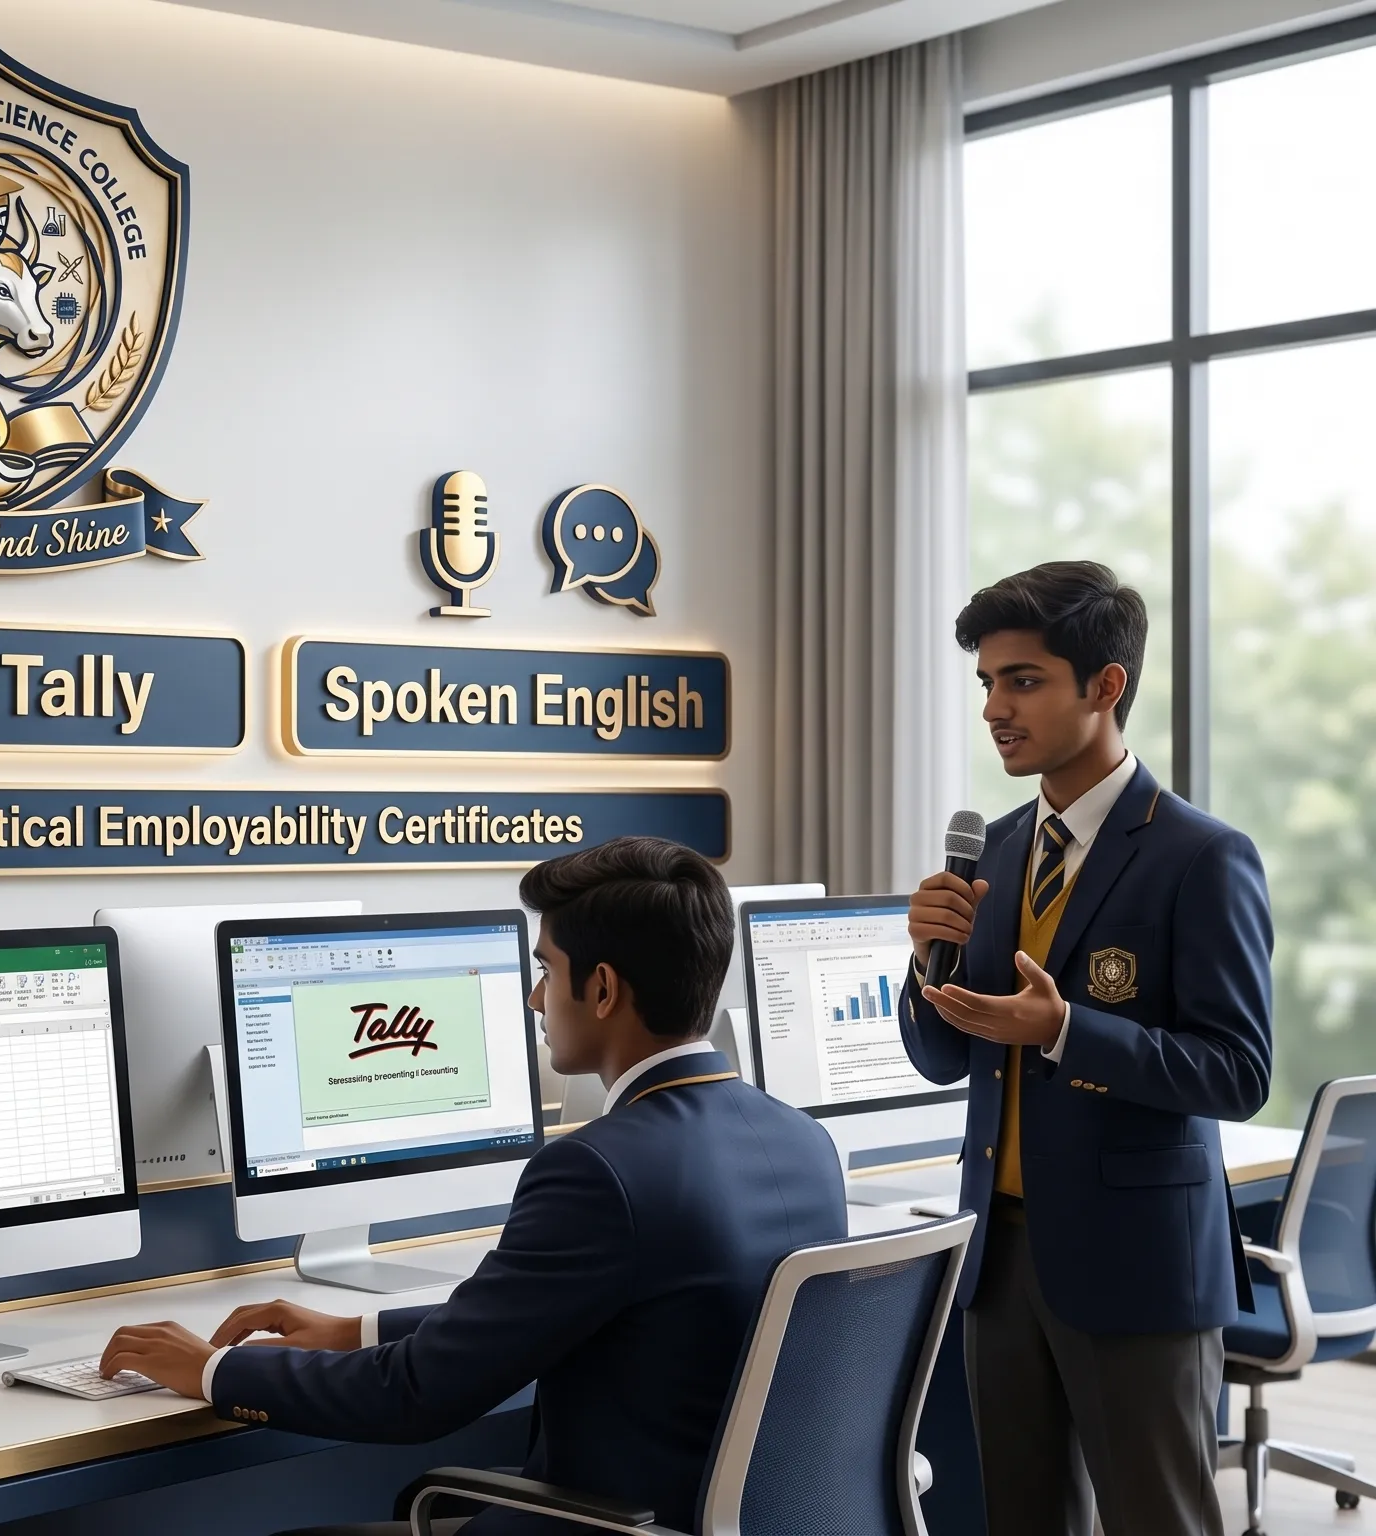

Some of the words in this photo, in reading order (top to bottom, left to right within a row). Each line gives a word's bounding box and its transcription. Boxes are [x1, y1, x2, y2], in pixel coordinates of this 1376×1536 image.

[79, 148, 146, 260] COLLEGE
[45, 517, 130, 557] Shine
[0, 653, 155, 735] Tally
[326, 665, 518, 736] Spoken
[535, 673, 704, 741] English
[99, 805, 367, 856] Employability
[378, 805, 584, 845] Certificates
[349, 1002, 435, 1057] Tally
